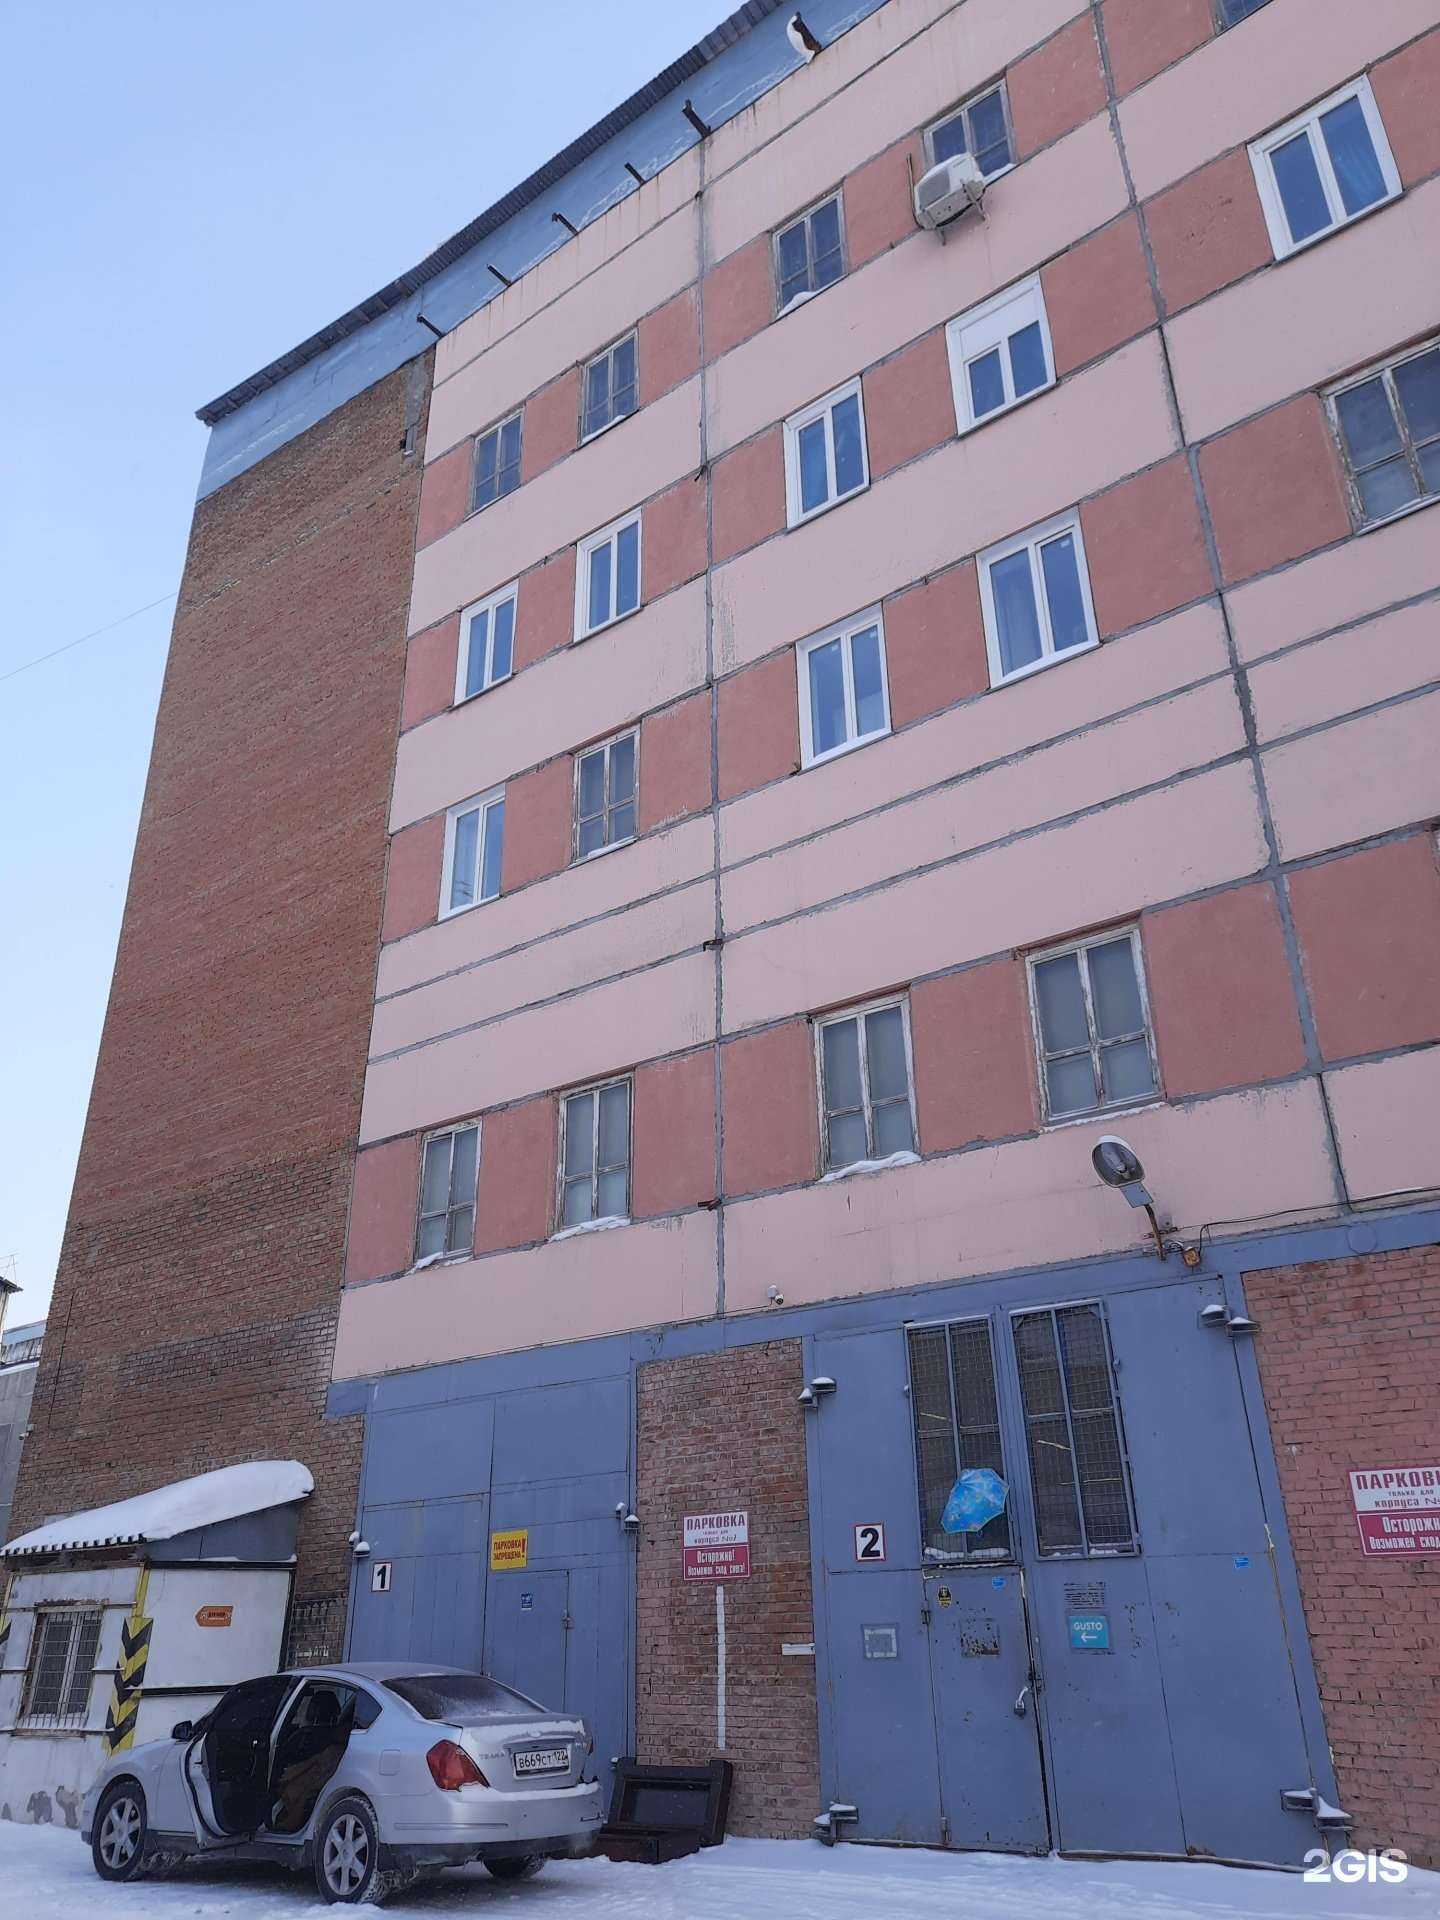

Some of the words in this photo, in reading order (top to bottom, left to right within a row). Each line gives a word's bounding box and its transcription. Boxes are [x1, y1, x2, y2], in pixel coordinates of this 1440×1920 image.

[1374, 1499, 1419, 1508] корпуса
[687, 1514, 745, 1530] ПАРКОВКА
[493, 1539, 521, 1551] ПАРКОВКА
[860, 1527, 881, 1558] 2
[1369, 1536, 1416, 1550] Возможен
[697, 1549, 735, 1565] Осторожно!
[377, 1565, 387, 1589] 1
[1074, 1622, 1103, 1631] GUSTO
